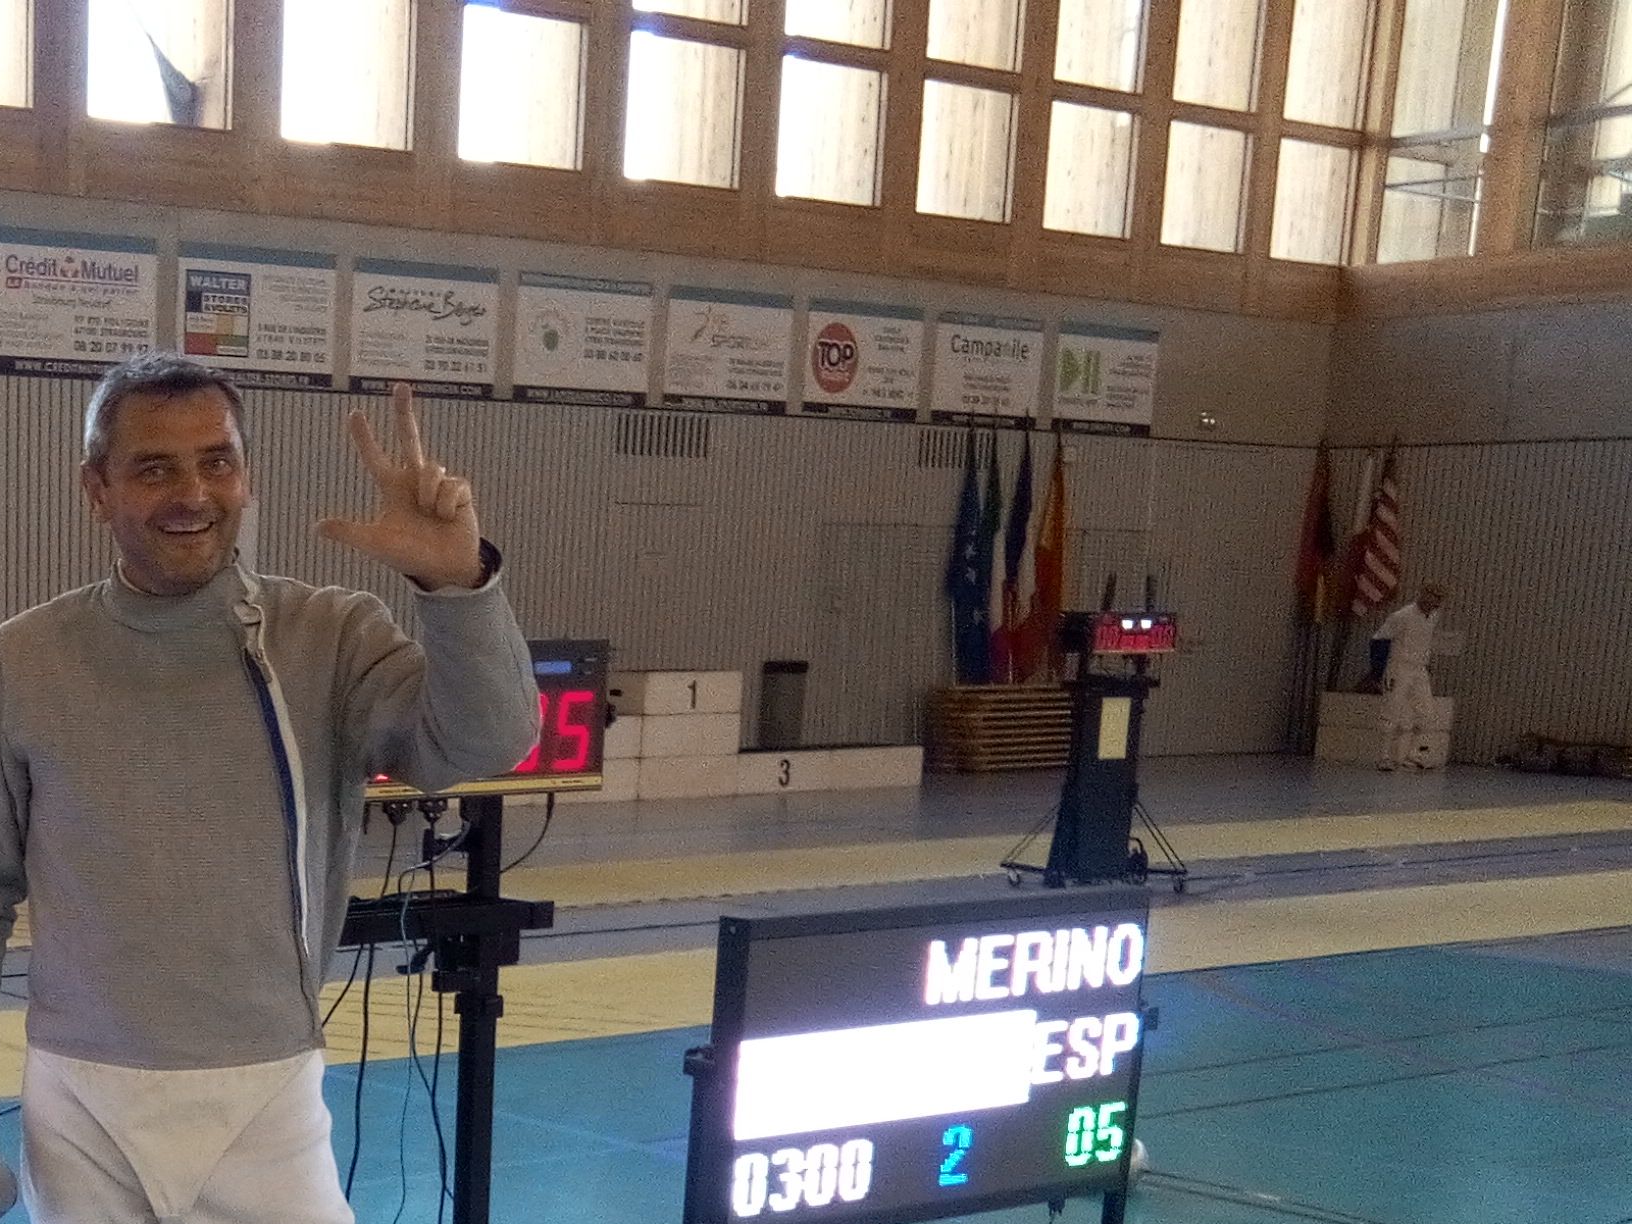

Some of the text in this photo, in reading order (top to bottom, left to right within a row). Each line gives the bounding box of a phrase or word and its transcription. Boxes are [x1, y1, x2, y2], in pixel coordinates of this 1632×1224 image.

[5, 253, 139, 283] Crédit Mutuel
[190, 275, 247, 291] WALTER
[687, 679, 697, 710] 1
[778, 758, 791, 788] 3
[924, 921, 1145, 1006] MERINO
[1028, 1010, 1142, 1086] ESP
[938, 1122, 973, 1188] 2
[1065, 1100, 1127, 1167] 05
